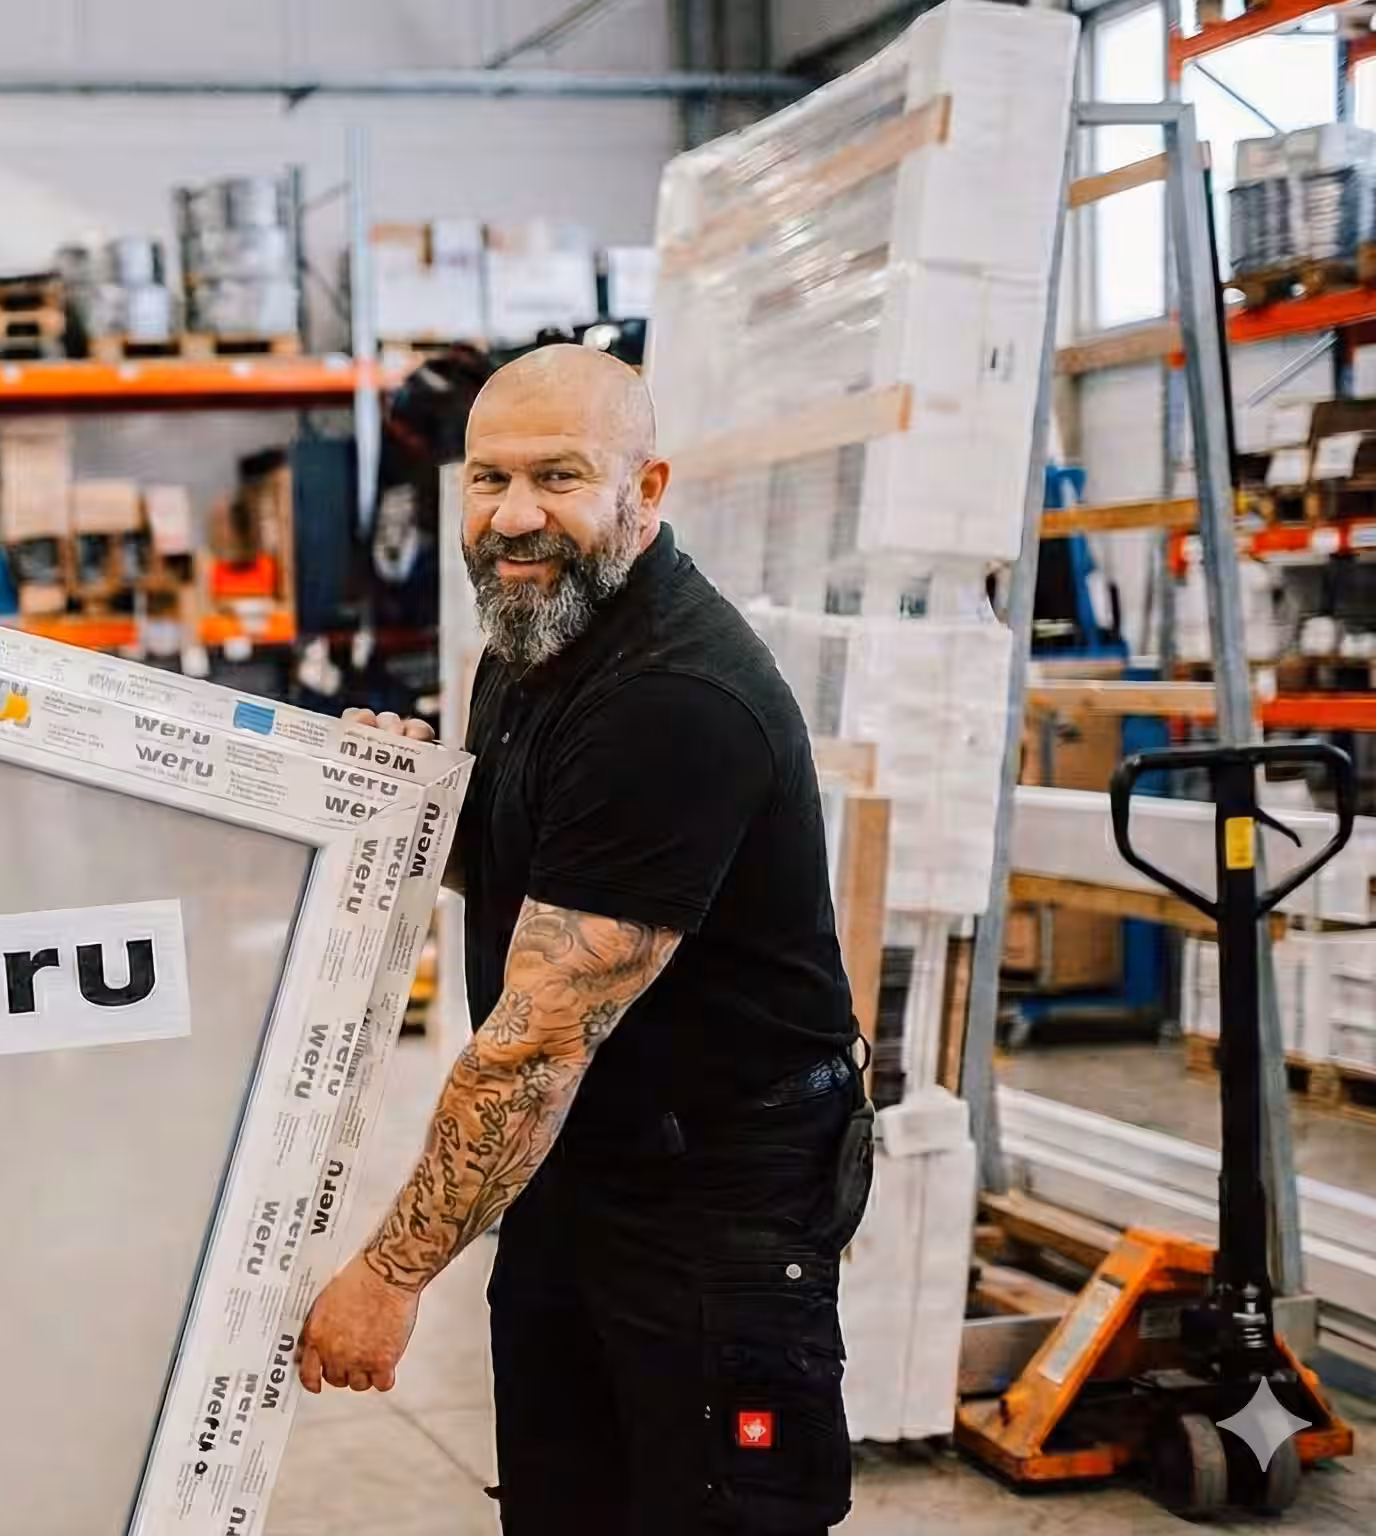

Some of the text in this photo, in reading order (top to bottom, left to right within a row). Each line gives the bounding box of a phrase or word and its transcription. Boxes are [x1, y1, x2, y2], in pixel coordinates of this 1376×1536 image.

[134, 713, 211, 746] weru
[136, 743, 214, 778] weru
[339, 741, 416, 773] weru
[322, 764, 399, 797] weru
[325, 795, 377, 820] wer
[346, 839, 379, 914] weru
[377, 836, 409, 912] weru
[409, 802, 441, 878] weru
[294, 1024, 328, 1099] weru
[327, 1022, 356, 1097] weru
[310, 1159, 344, 1235] weru
[247, 1201, 280, 1275] weru
